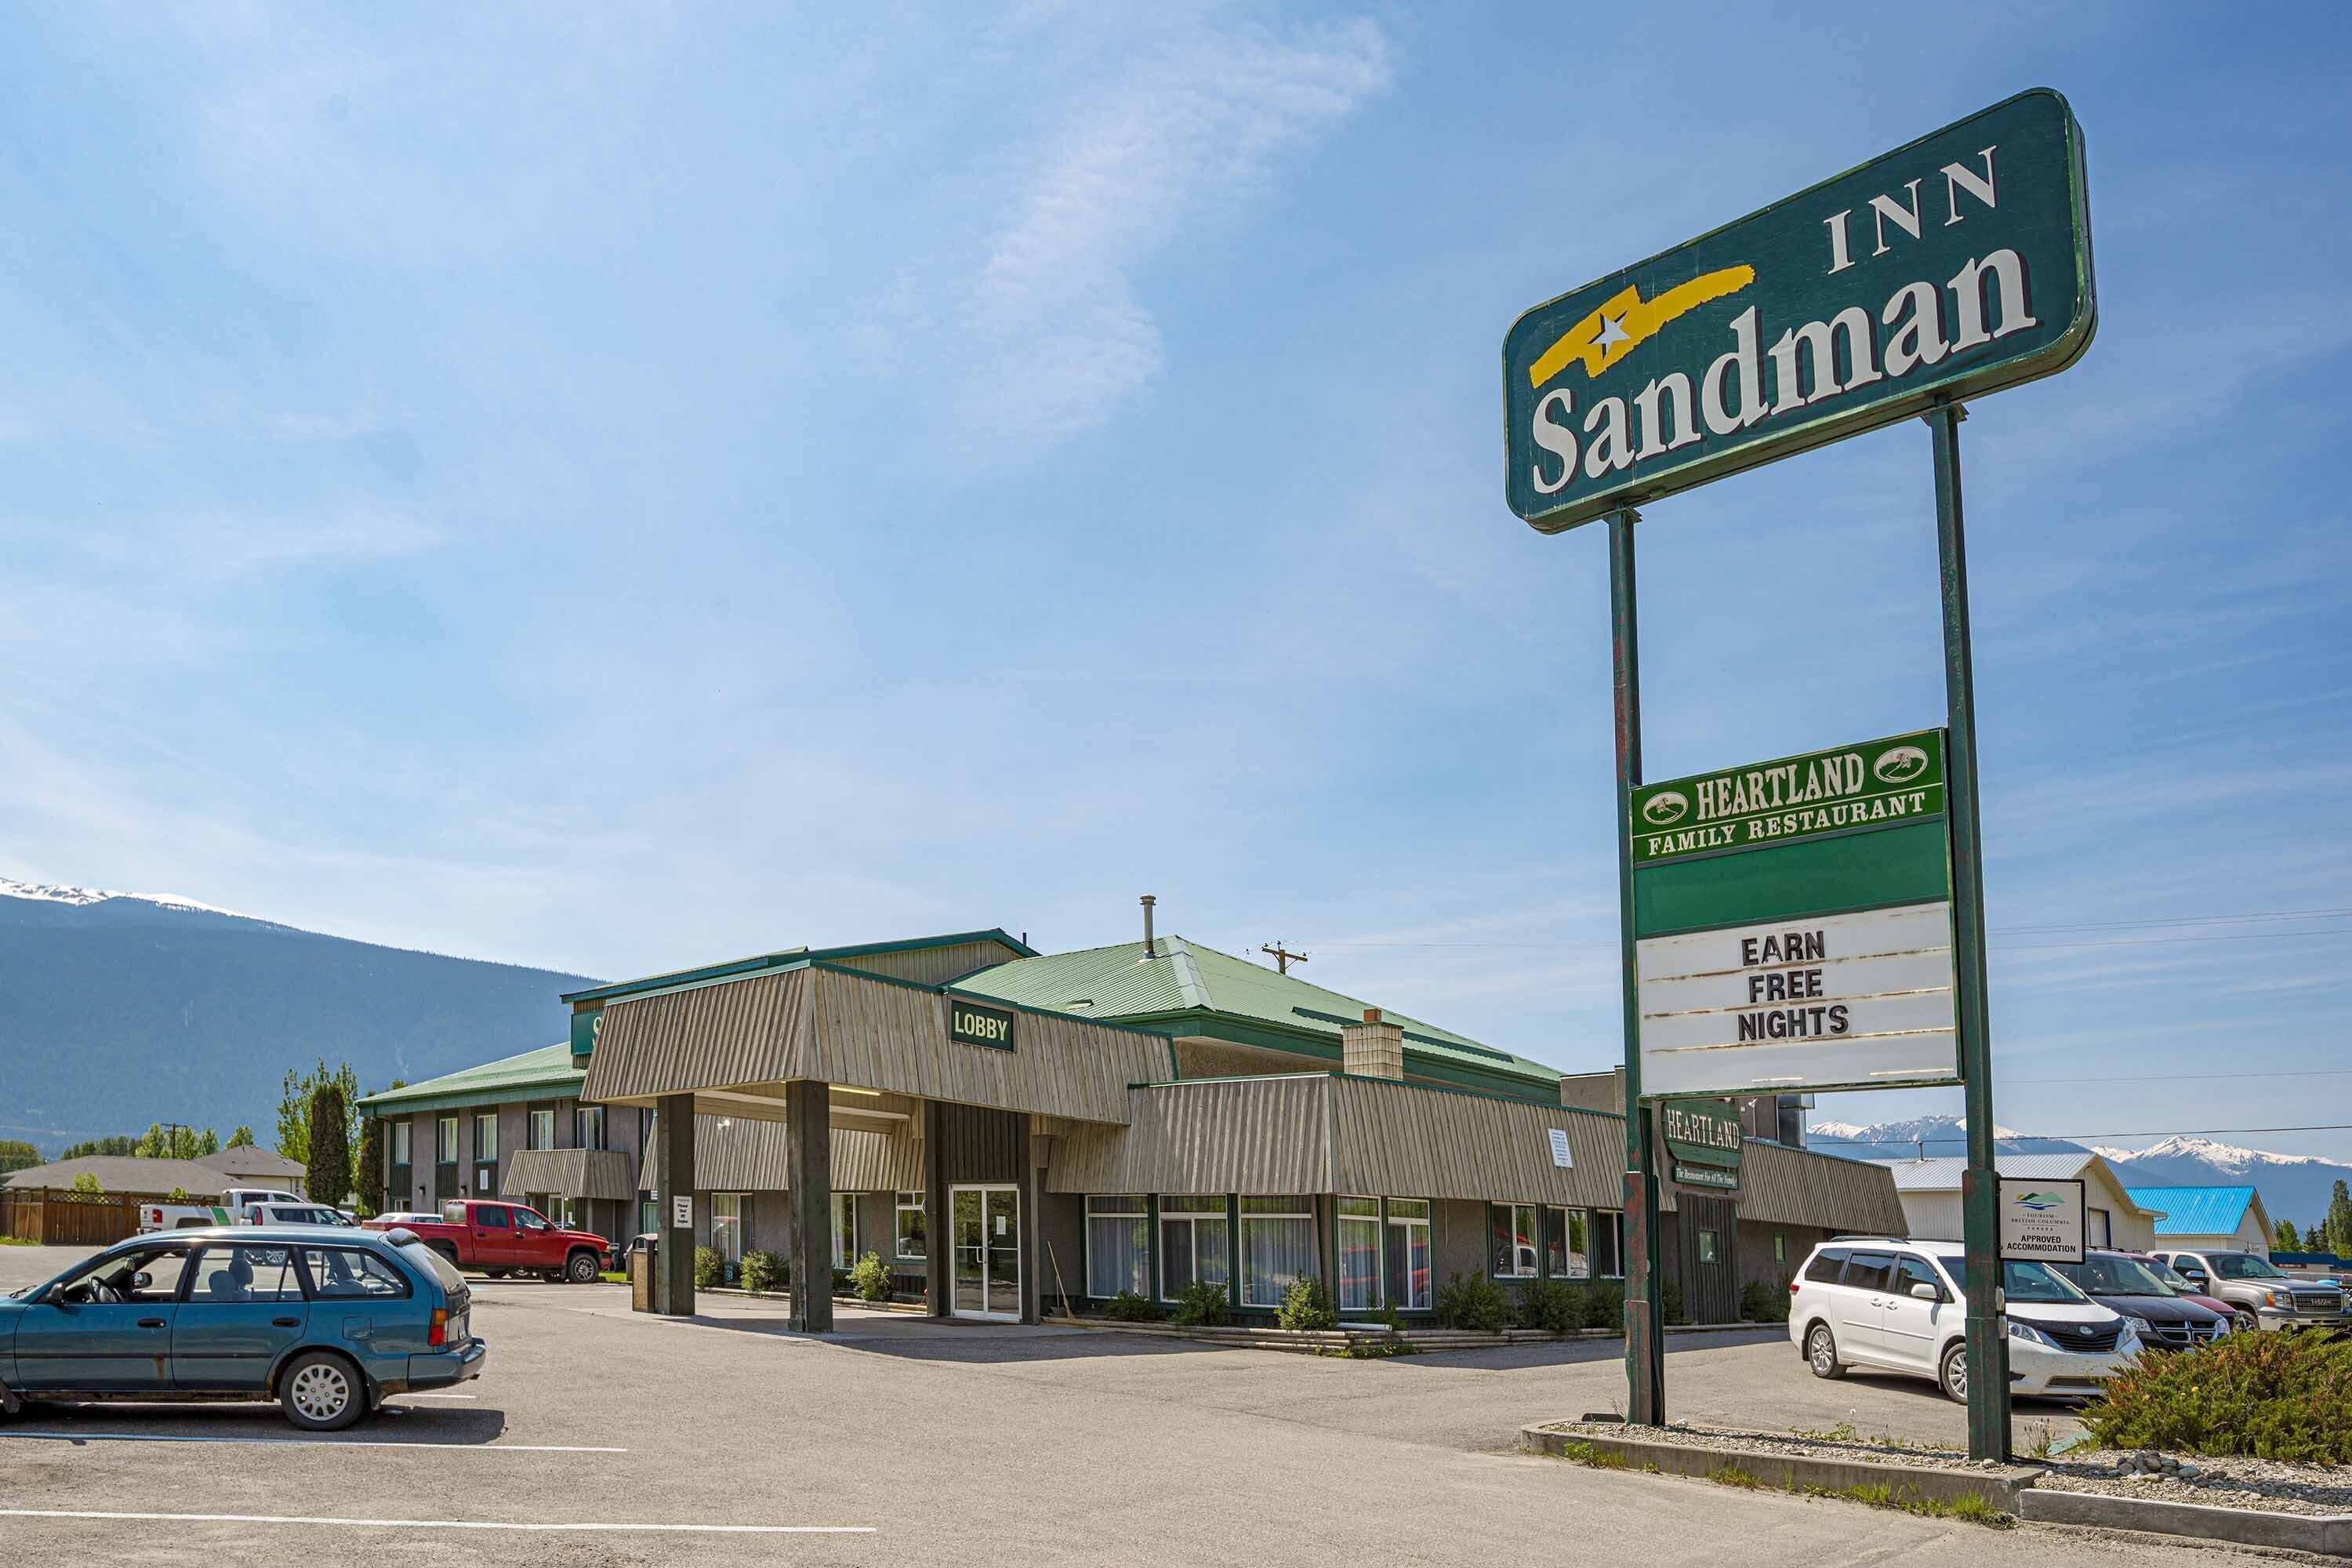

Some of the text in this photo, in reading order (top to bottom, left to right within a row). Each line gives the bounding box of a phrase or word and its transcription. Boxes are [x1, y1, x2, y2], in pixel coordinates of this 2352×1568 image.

[1824, 145, 1998, 275] INN
[1531, 248, 2037, 495] Sandman
[1696, 752, 1864, 821] HEARTLAND
[1648, 792, 1926, 856] FAMILY RESTAURANT
[1741, 930, 1826, 967] EARN
[1748, 968, 1824, 1004] FREE
[954, 1011, 1008, 1041] LOBBY
[1737, 1004, 1849, 1042] NIGHTS
[1667, 1109, 1740, 1149] HEARTLAND
[2006, 1243, 2076, 1253] ACCOMMODATION
[2020, 1235, 2061, 1243] APPROVED
